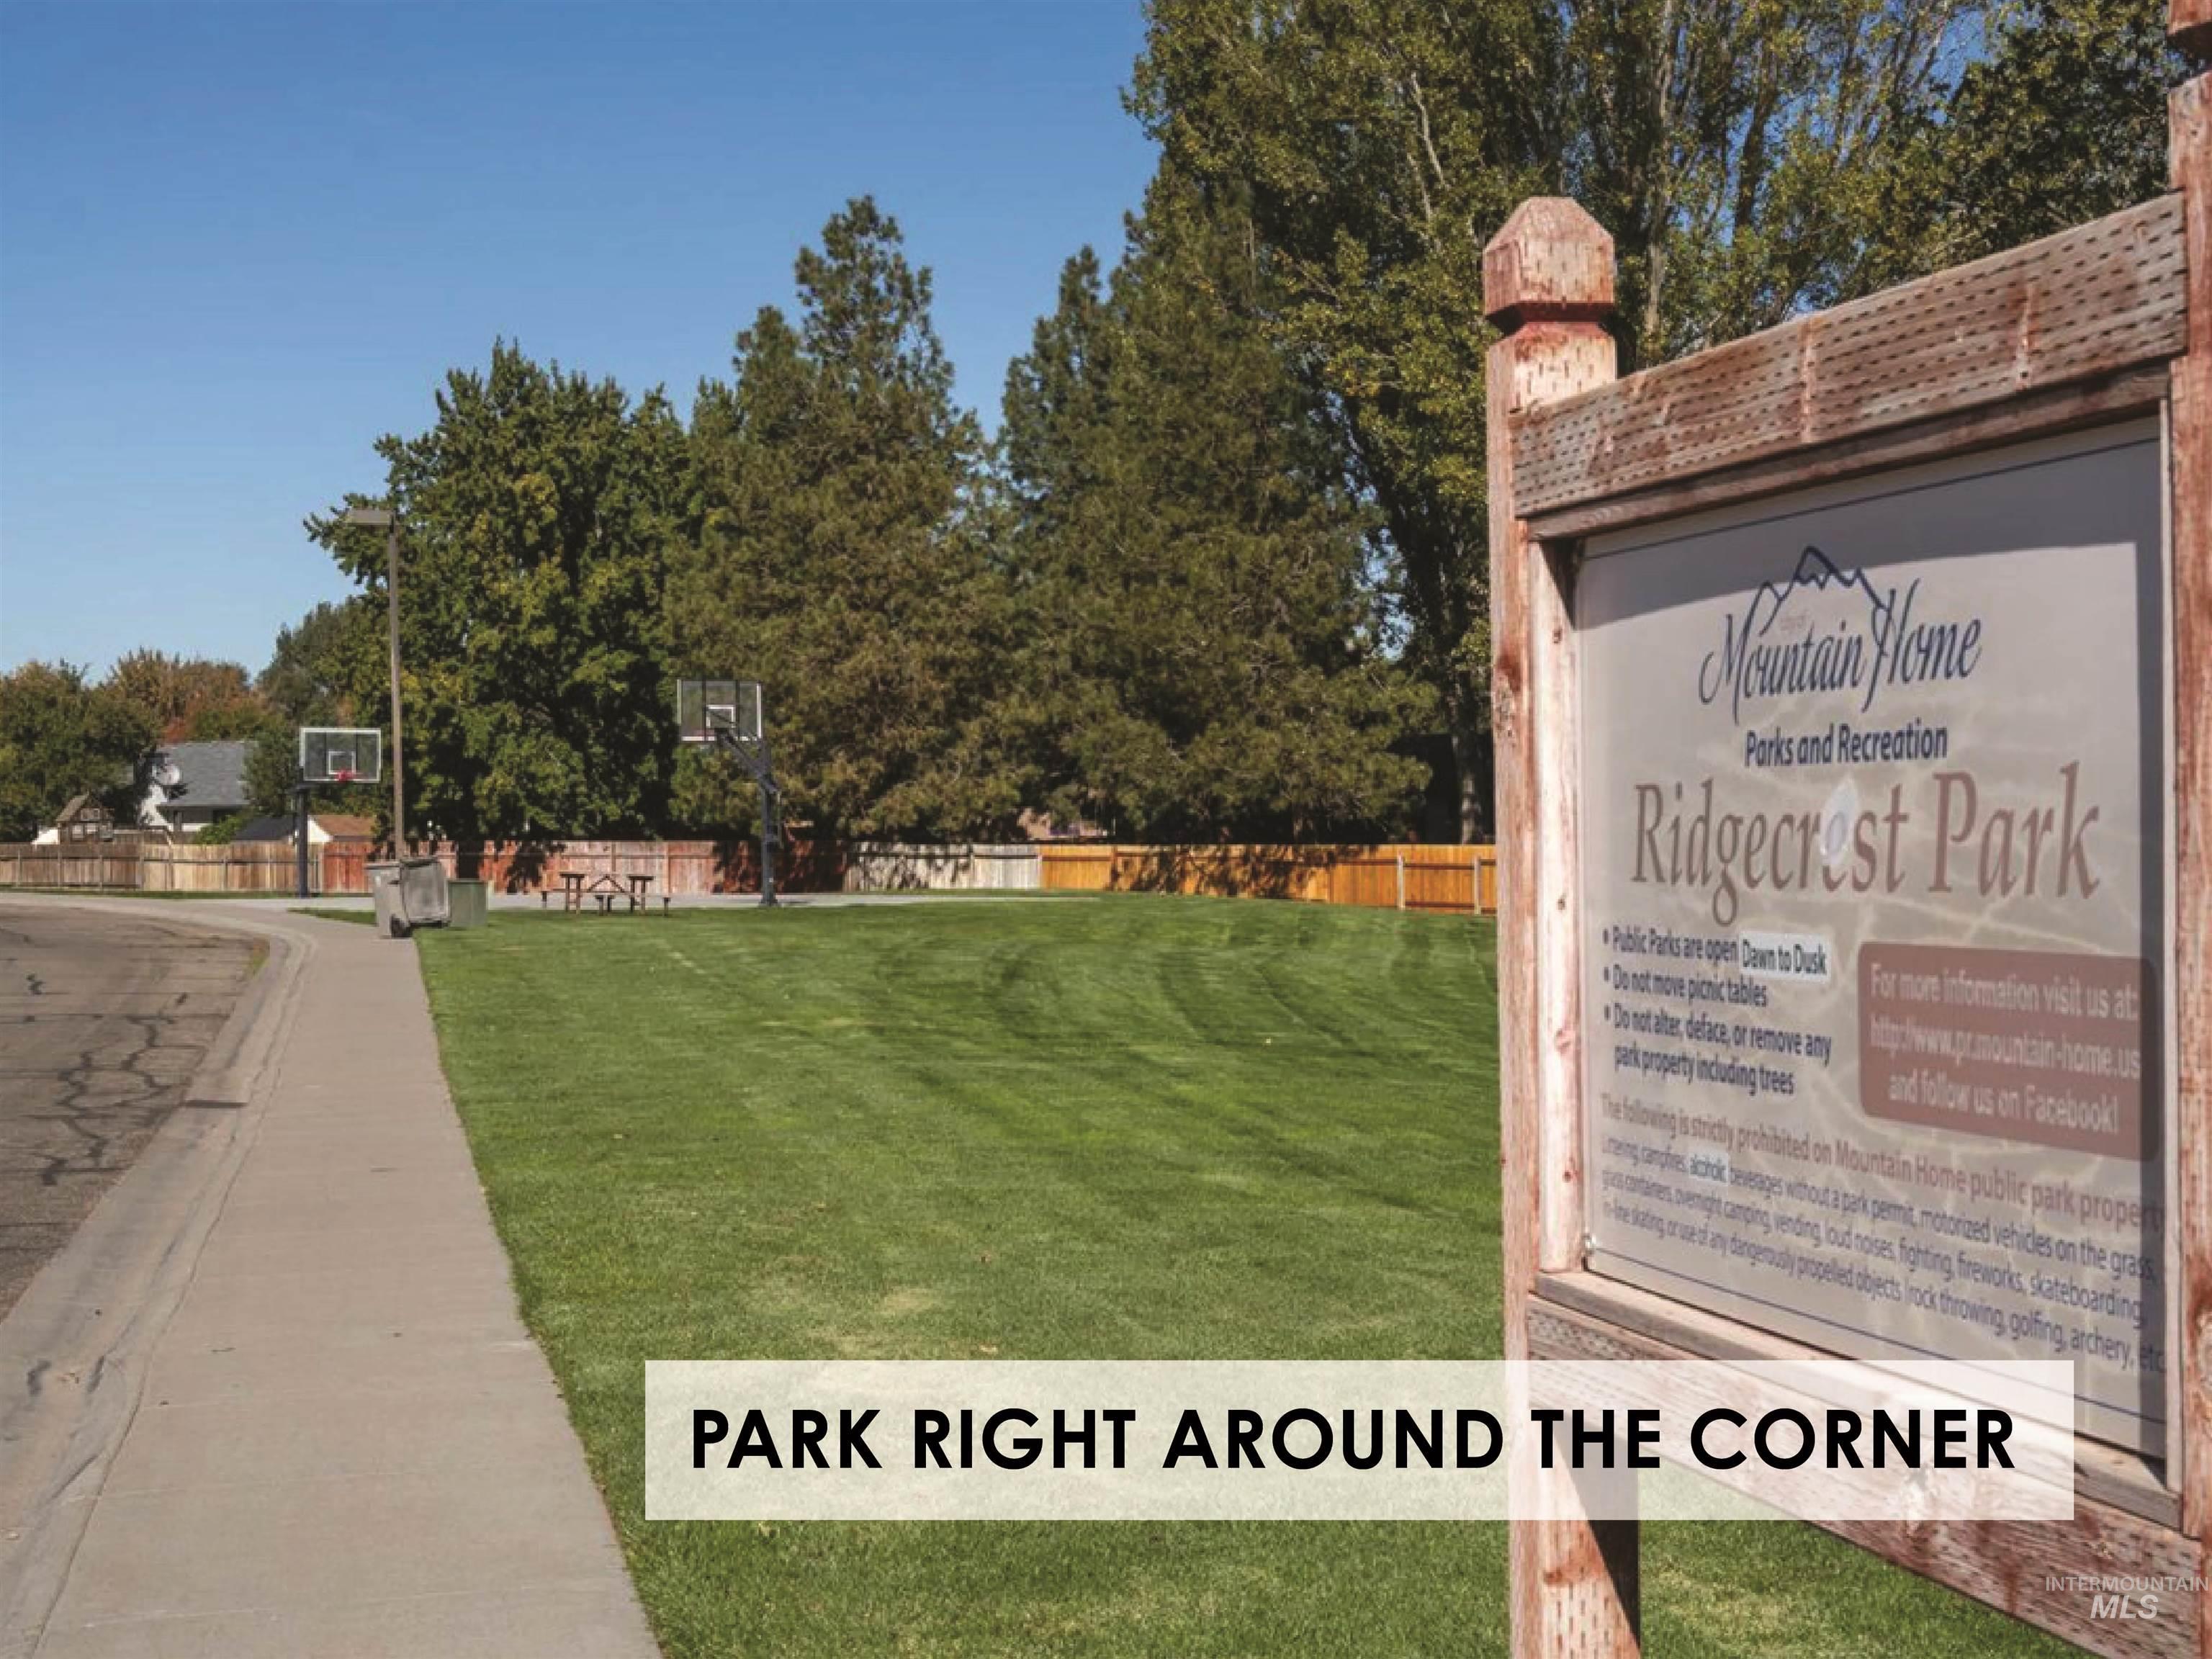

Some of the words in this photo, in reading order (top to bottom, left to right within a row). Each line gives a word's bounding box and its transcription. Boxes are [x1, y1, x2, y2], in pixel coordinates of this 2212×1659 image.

[1699, 592, 1866, 726] Mountain
[1862, 578, 1982, 713] Home
[1745, 726, 1794, 768] Parks
[1797, 723, 1834, 765] and
[1838, 717, 1948, 763] Recreation
[1928, 760, 2100, 899] Park
[1613, 925, 1647, 954] Public
[1648, 927, 1681, 957] Parks
[1683, 937, 1704, 960] are
[1704, 938, 1740, 967] open
[1743, 939, 1777, 970] Dawn
[1778, 945, 1792, 972] to
[1793, 943, 1827, 974] Dusk
[1613, 963, 1630, 991] Do
[1632, 969, 1652, 994] not
[1653, 974, 1685, 997] move
[1688, 972, 1725, 1006] picnic
[1727, 974, 1768, 1008] tables
[1871, 962, 1898, 1002] For
[1899, 971, 1942, 1002] more
[1943, 967, 2039, 1012] information
[2043, 974, 2082, 1017] visit
[2087, 986, 2109, 1019] us
[2113, 983, 2139, 1021] at:
[1614, 1002, 1630, 1030] Do
[1632, 1009, 1652, 1033] not
[1686, 1010, 1730, 1048] deface,
[1733, 1025, 1748, 1046] or
[1750, 1027, 1802, 1056] remove
[1805, 1033, 1833, 1068] any
[1614, 1040, 1640, 1073] park
[1642, 1050, 1694, 1085] property
[1696, 1053, 1757, 1097] including
[1758, 1063, 1794, 1095] trees
[1889, 1069, 1918, 1104] and
[1920, 1069, 1971, 1113] follow
[1974, 1084, 1995, 1117] us
[1998, 1087, 2021, 1120] on
[1737, 1123, 1810, 1161] prohibited
[1813, 1141, 1833, 1166] on
[1836, 1138, 1912, 1184] Mountain
[1915, 1154, 1966, 1193] Home
[1970, 1166, 2026, 1204] public
[2032, 1179, 2075, 1217] park
[2080, 1192, 2164, 1233] propert
[2055, 1238, 2077, 1262] on
[2080, 1237, 2107, 1270] the
